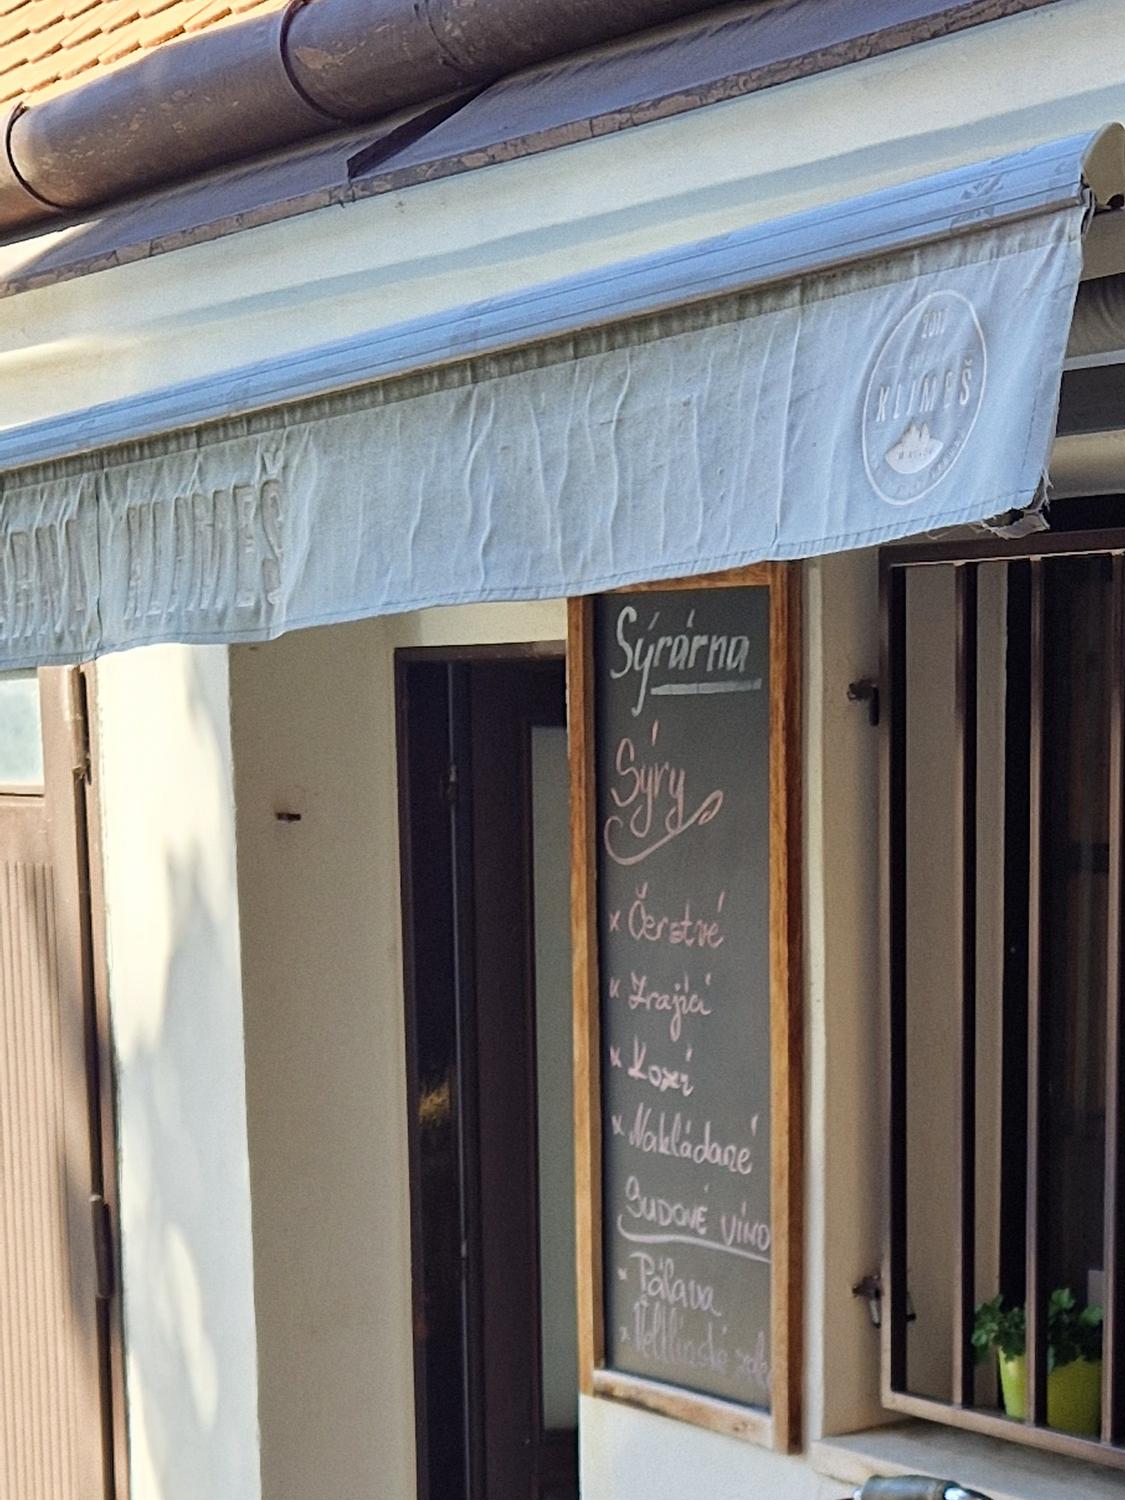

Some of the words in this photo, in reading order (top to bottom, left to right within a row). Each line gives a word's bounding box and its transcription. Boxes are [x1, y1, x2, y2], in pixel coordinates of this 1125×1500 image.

[610, 606, 750, 717] Sýrárna
[610, 719, 686, 838] Sýry
[629, 1102, 757, 1175] Nakládané
